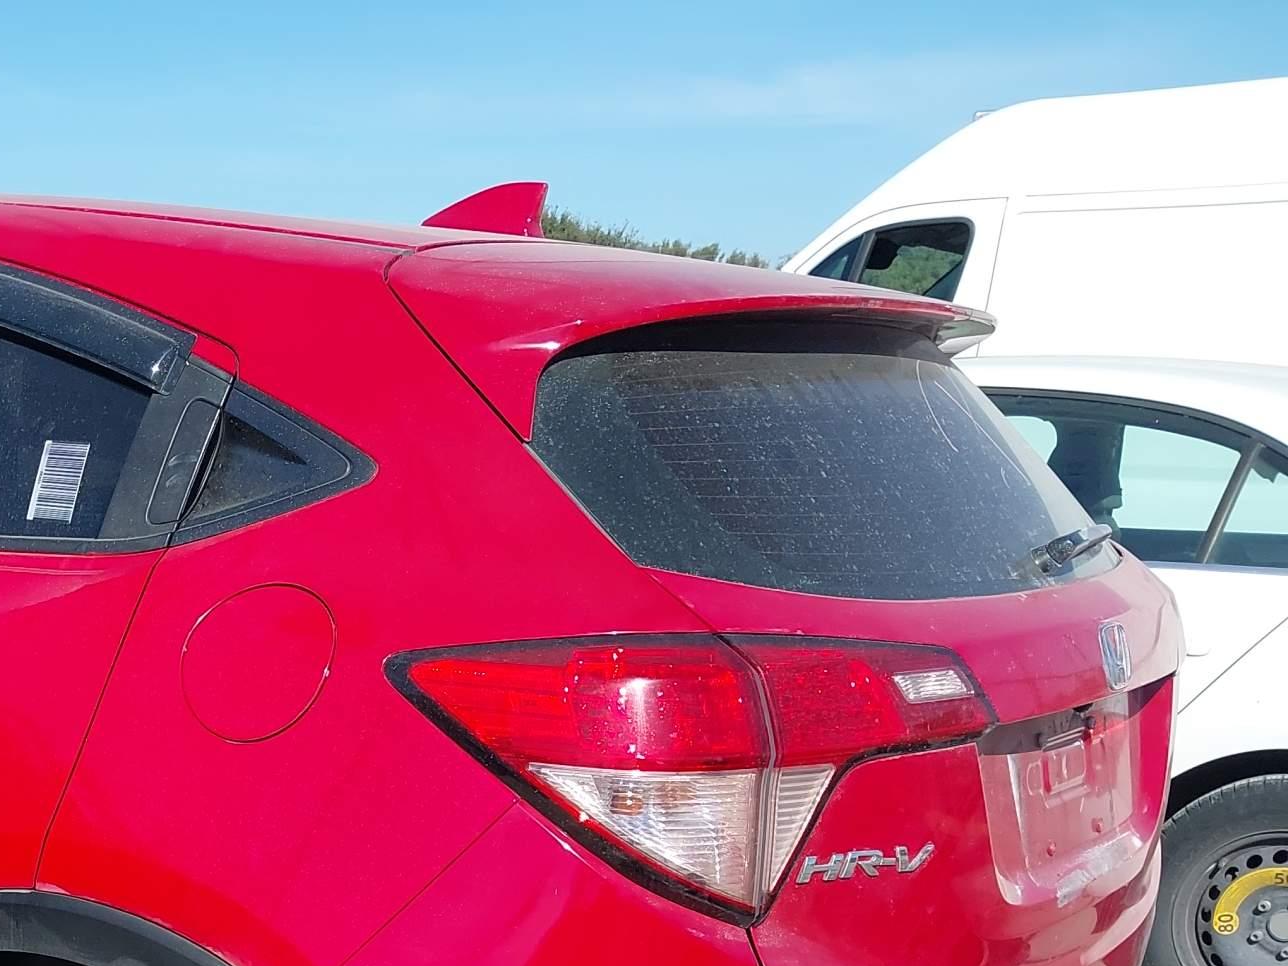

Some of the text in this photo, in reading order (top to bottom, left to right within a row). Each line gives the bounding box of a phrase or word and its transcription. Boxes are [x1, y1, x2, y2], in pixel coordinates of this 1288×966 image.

[796, 841, 935, 884] HR-V
[1274, 872, 1288, 885] 5
[1218, 914, 1234, 933] 80
